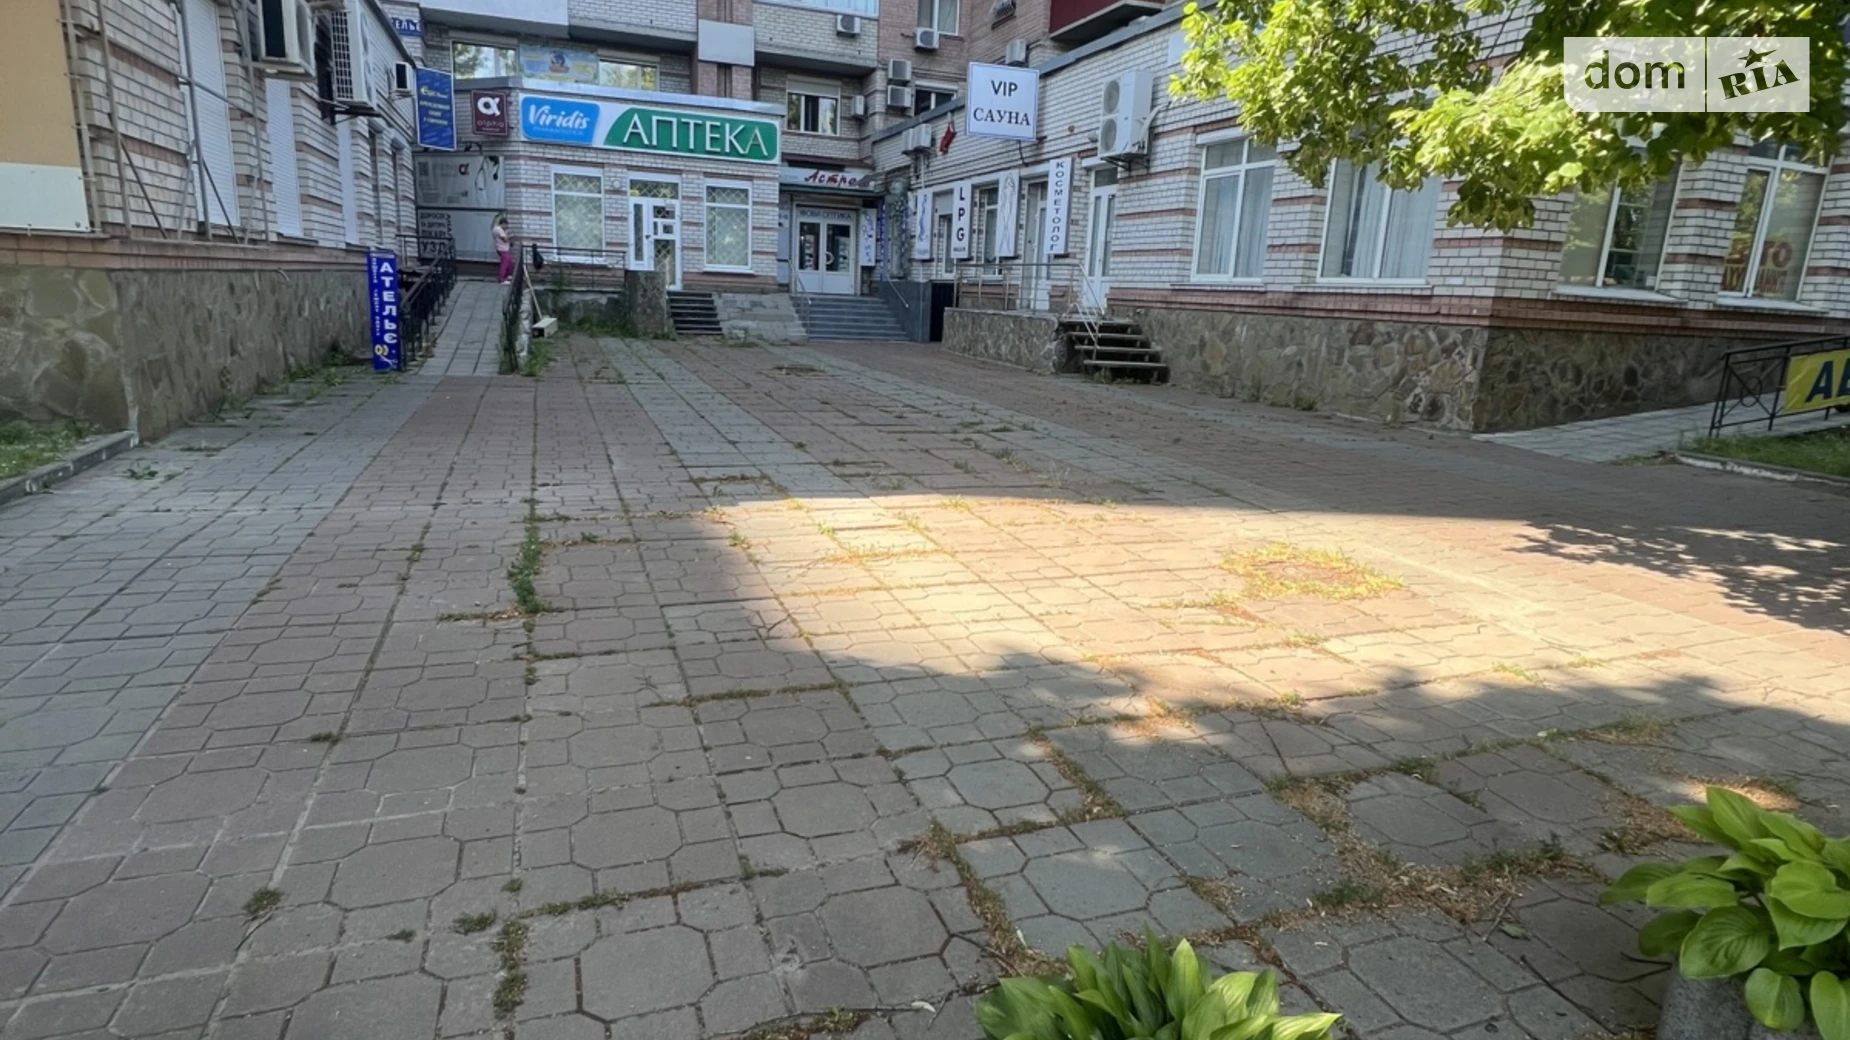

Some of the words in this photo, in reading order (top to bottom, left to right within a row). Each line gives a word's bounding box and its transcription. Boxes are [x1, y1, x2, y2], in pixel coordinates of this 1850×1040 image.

[991, 80, 1018, 97] VIP
[529, 104, 591, 129] Viridis
[973, 107, 1031, 126] САУНА
[623, 112, 768, 156] АПТЕКА
[1049, 161, 1065, 251] КОСМЕТОЛОГ
[379, 262, 398, 343] АТЕЛЬЄ
